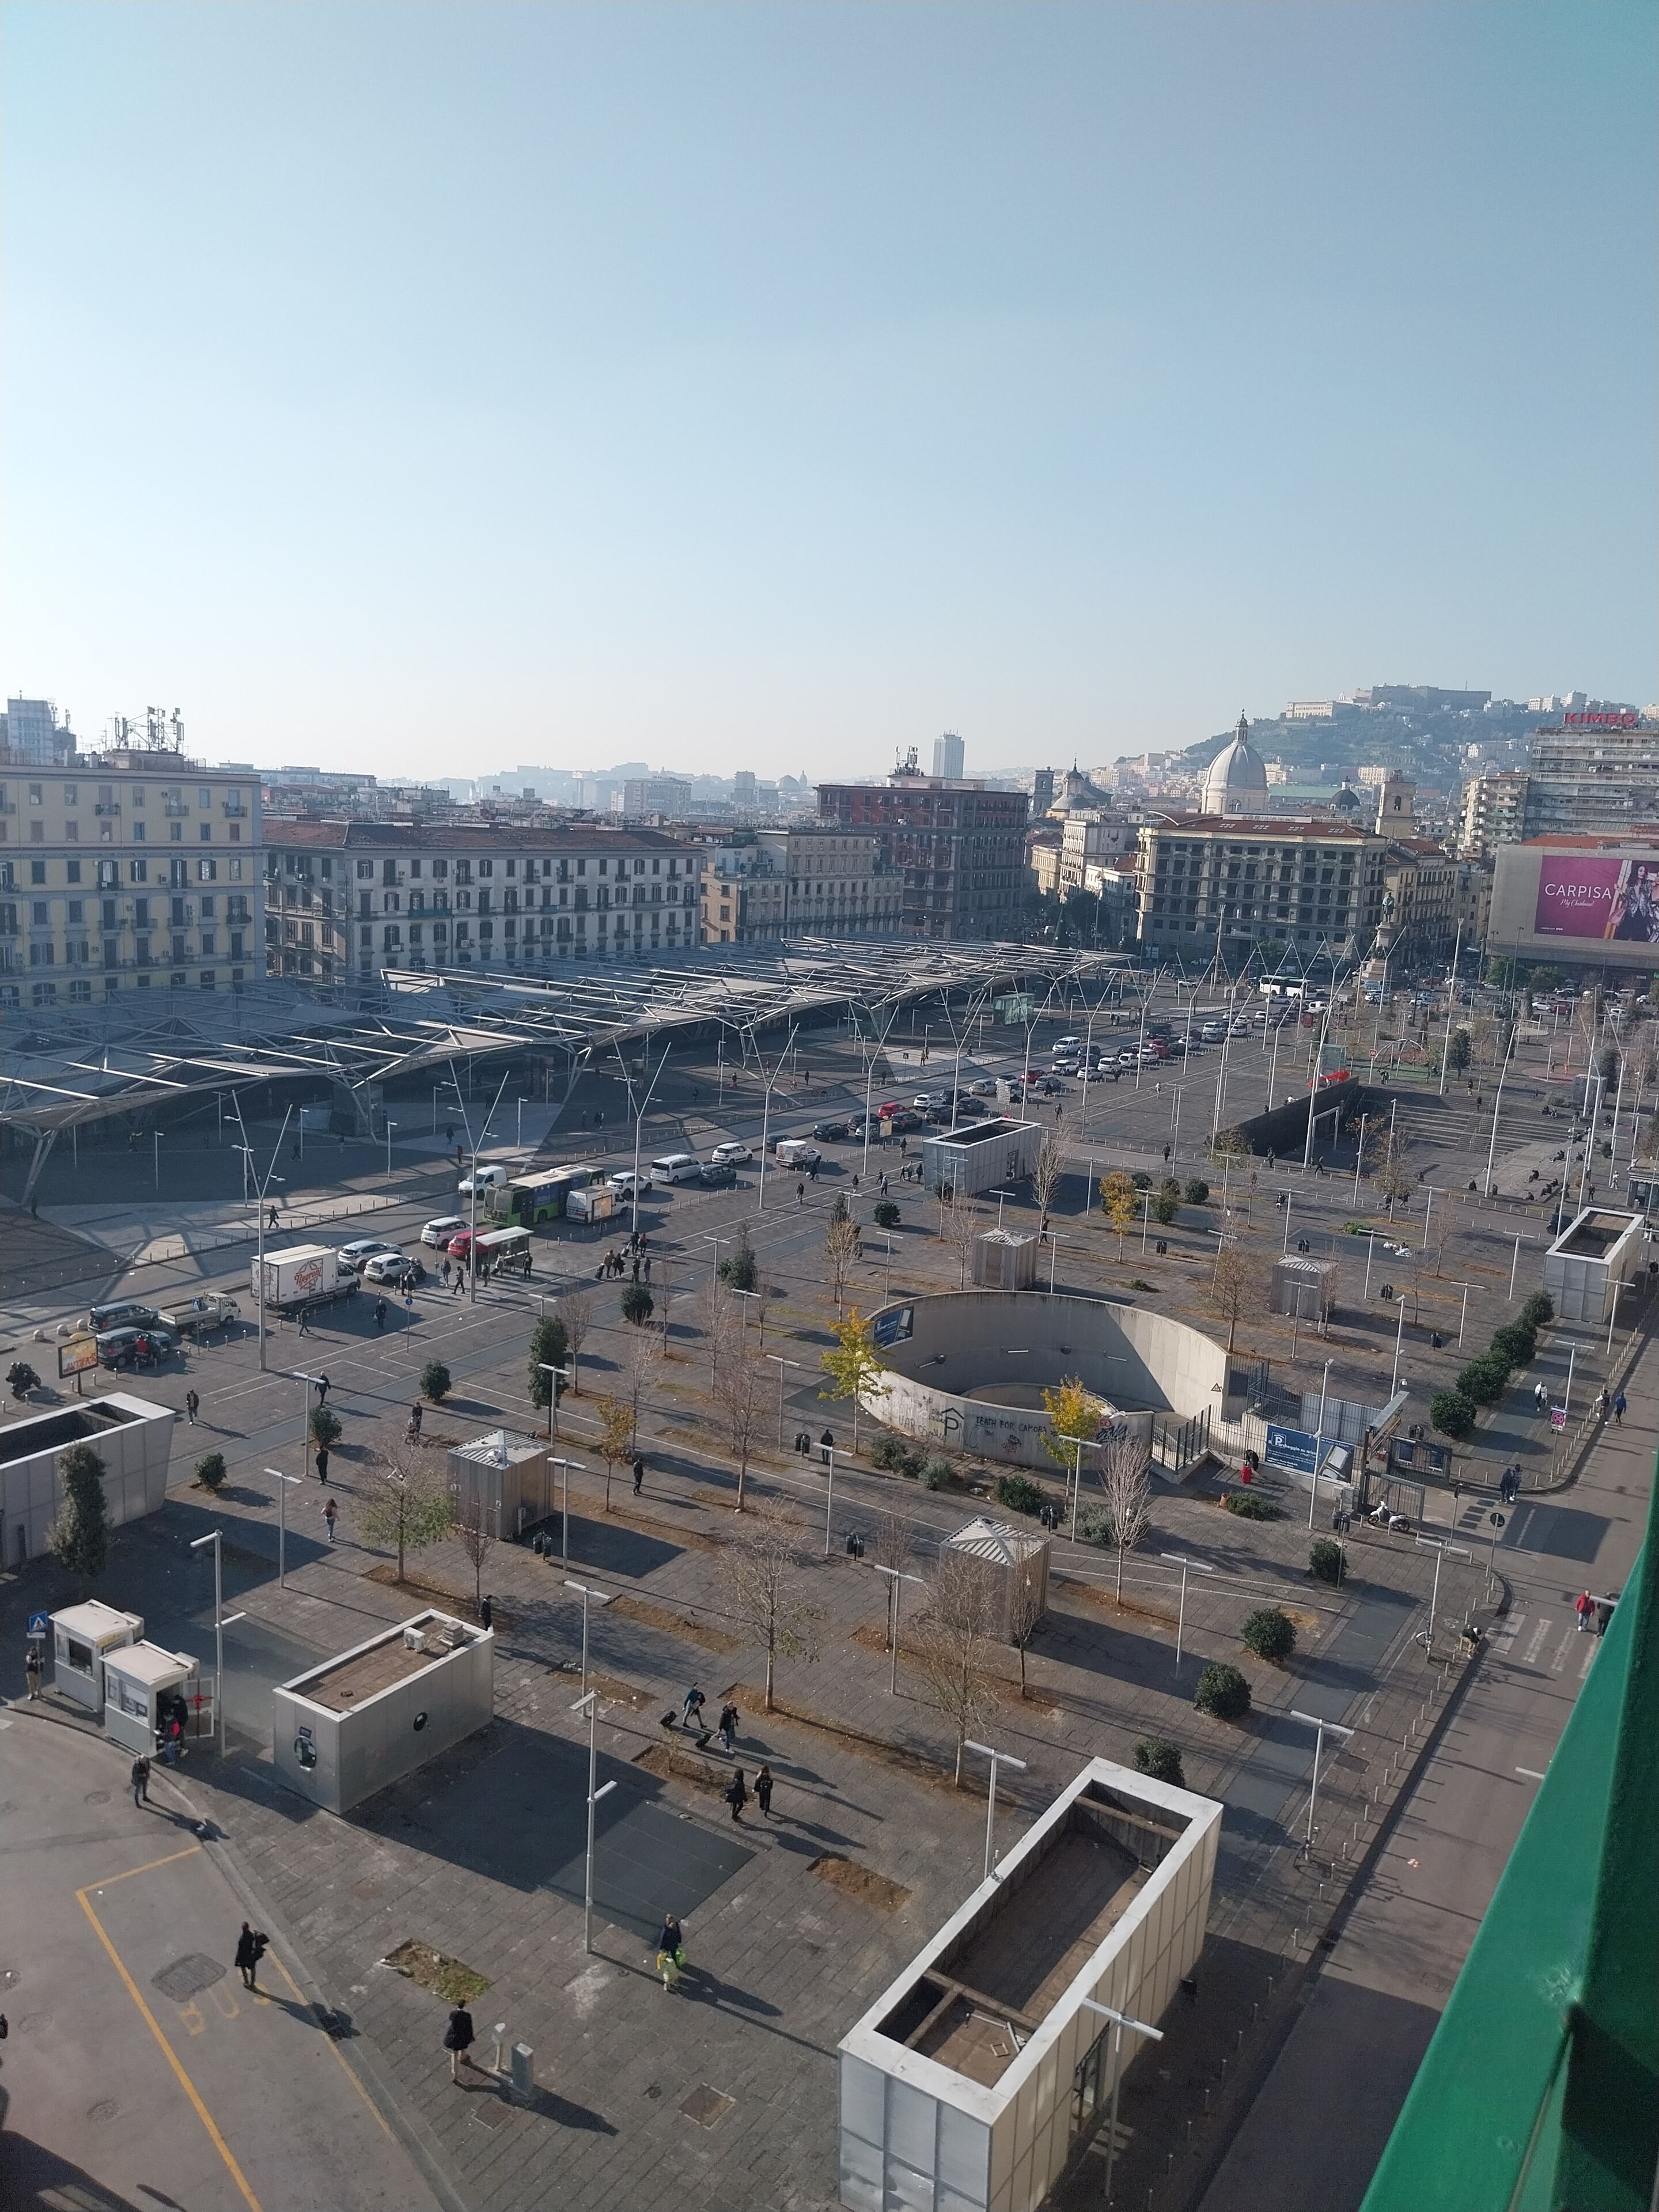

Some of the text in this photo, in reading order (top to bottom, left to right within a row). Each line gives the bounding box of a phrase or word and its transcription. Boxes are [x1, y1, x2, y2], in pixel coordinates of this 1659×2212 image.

[1565, 713, 1635, 725] KIMBO
[1545, 884, 1611, 899] CARPISA
[1560, 899, 1570, 908] My
[294, 1267, 322, 1285] Negroni
[1000, 1420, 1015, 1430] FOR
[1275, 1436, 1300, 1451] Parcheggio
